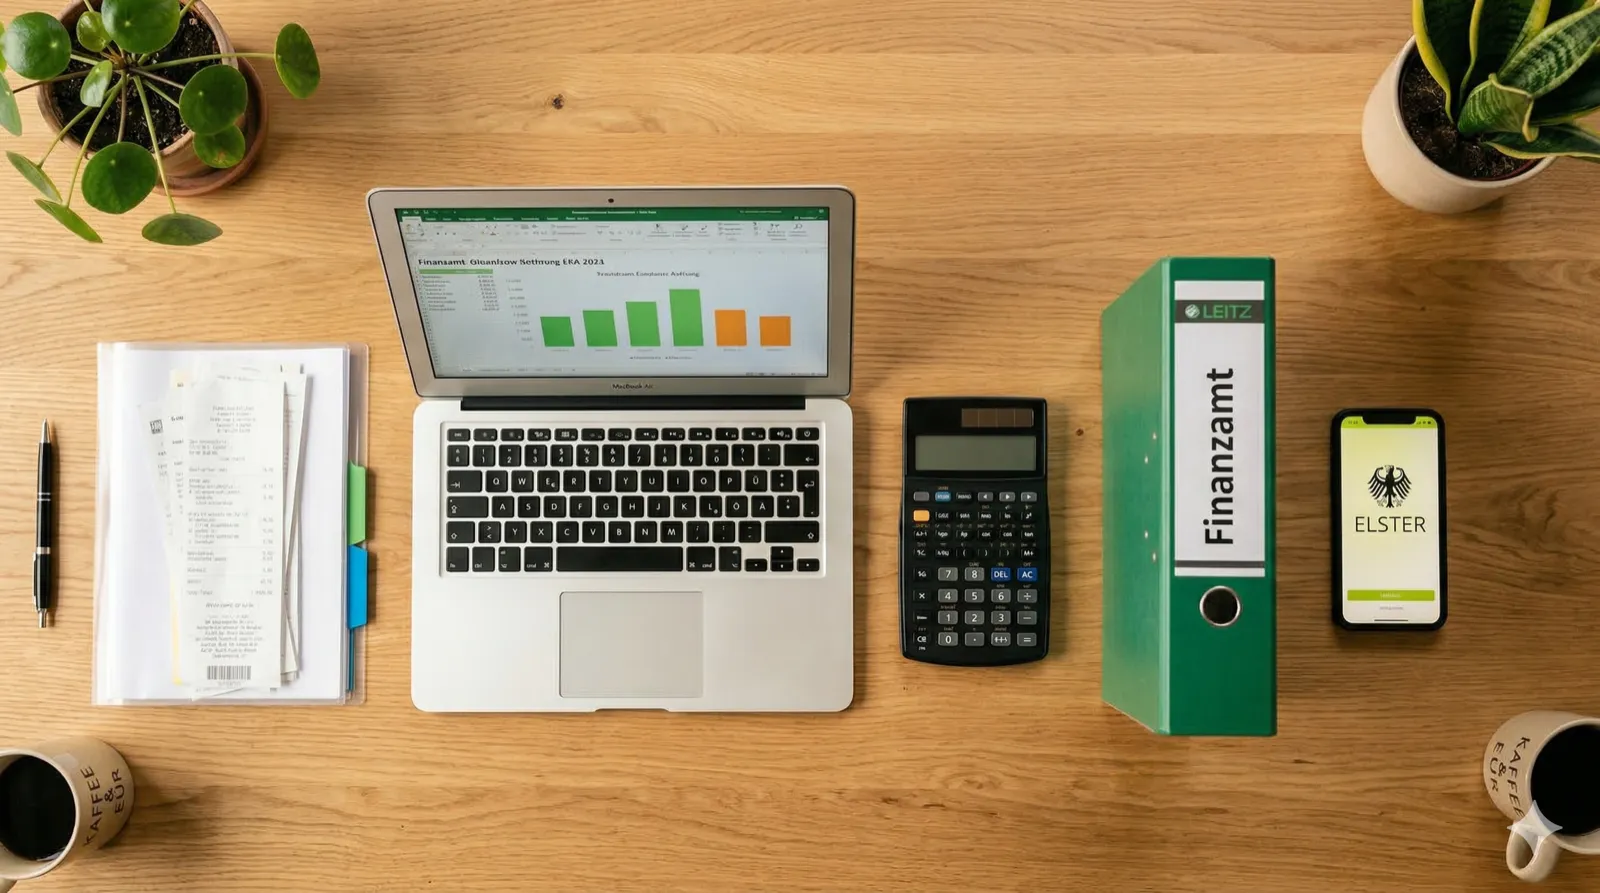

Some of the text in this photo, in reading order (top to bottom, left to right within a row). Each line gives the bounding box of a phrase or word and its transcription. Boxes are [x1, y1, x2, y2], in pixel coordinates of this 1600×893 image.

[1203, 304, 1253, 319] LEITZ
[1203, 368, 1234, 544] Finanzamt
[1355, 516, 1426, 533] ELSTER
[945, 569, 1033, 579] 7 8 DEL AC
[944, 591, 952, 600] 4
[971, 591, 978, 601] 5
[998, 591, 1005, 601] 6
[971, 613, 978, 623] 2
[998, 613, 1005, 623] 3
[945, 635, 952, 644] 0
[1498, 762, 1507, 777] &
[1507, 737, 1531, 818] KAFFEE
[104, 787, 114, 802] &
[81, 766, 103, 847] KAFFEE
